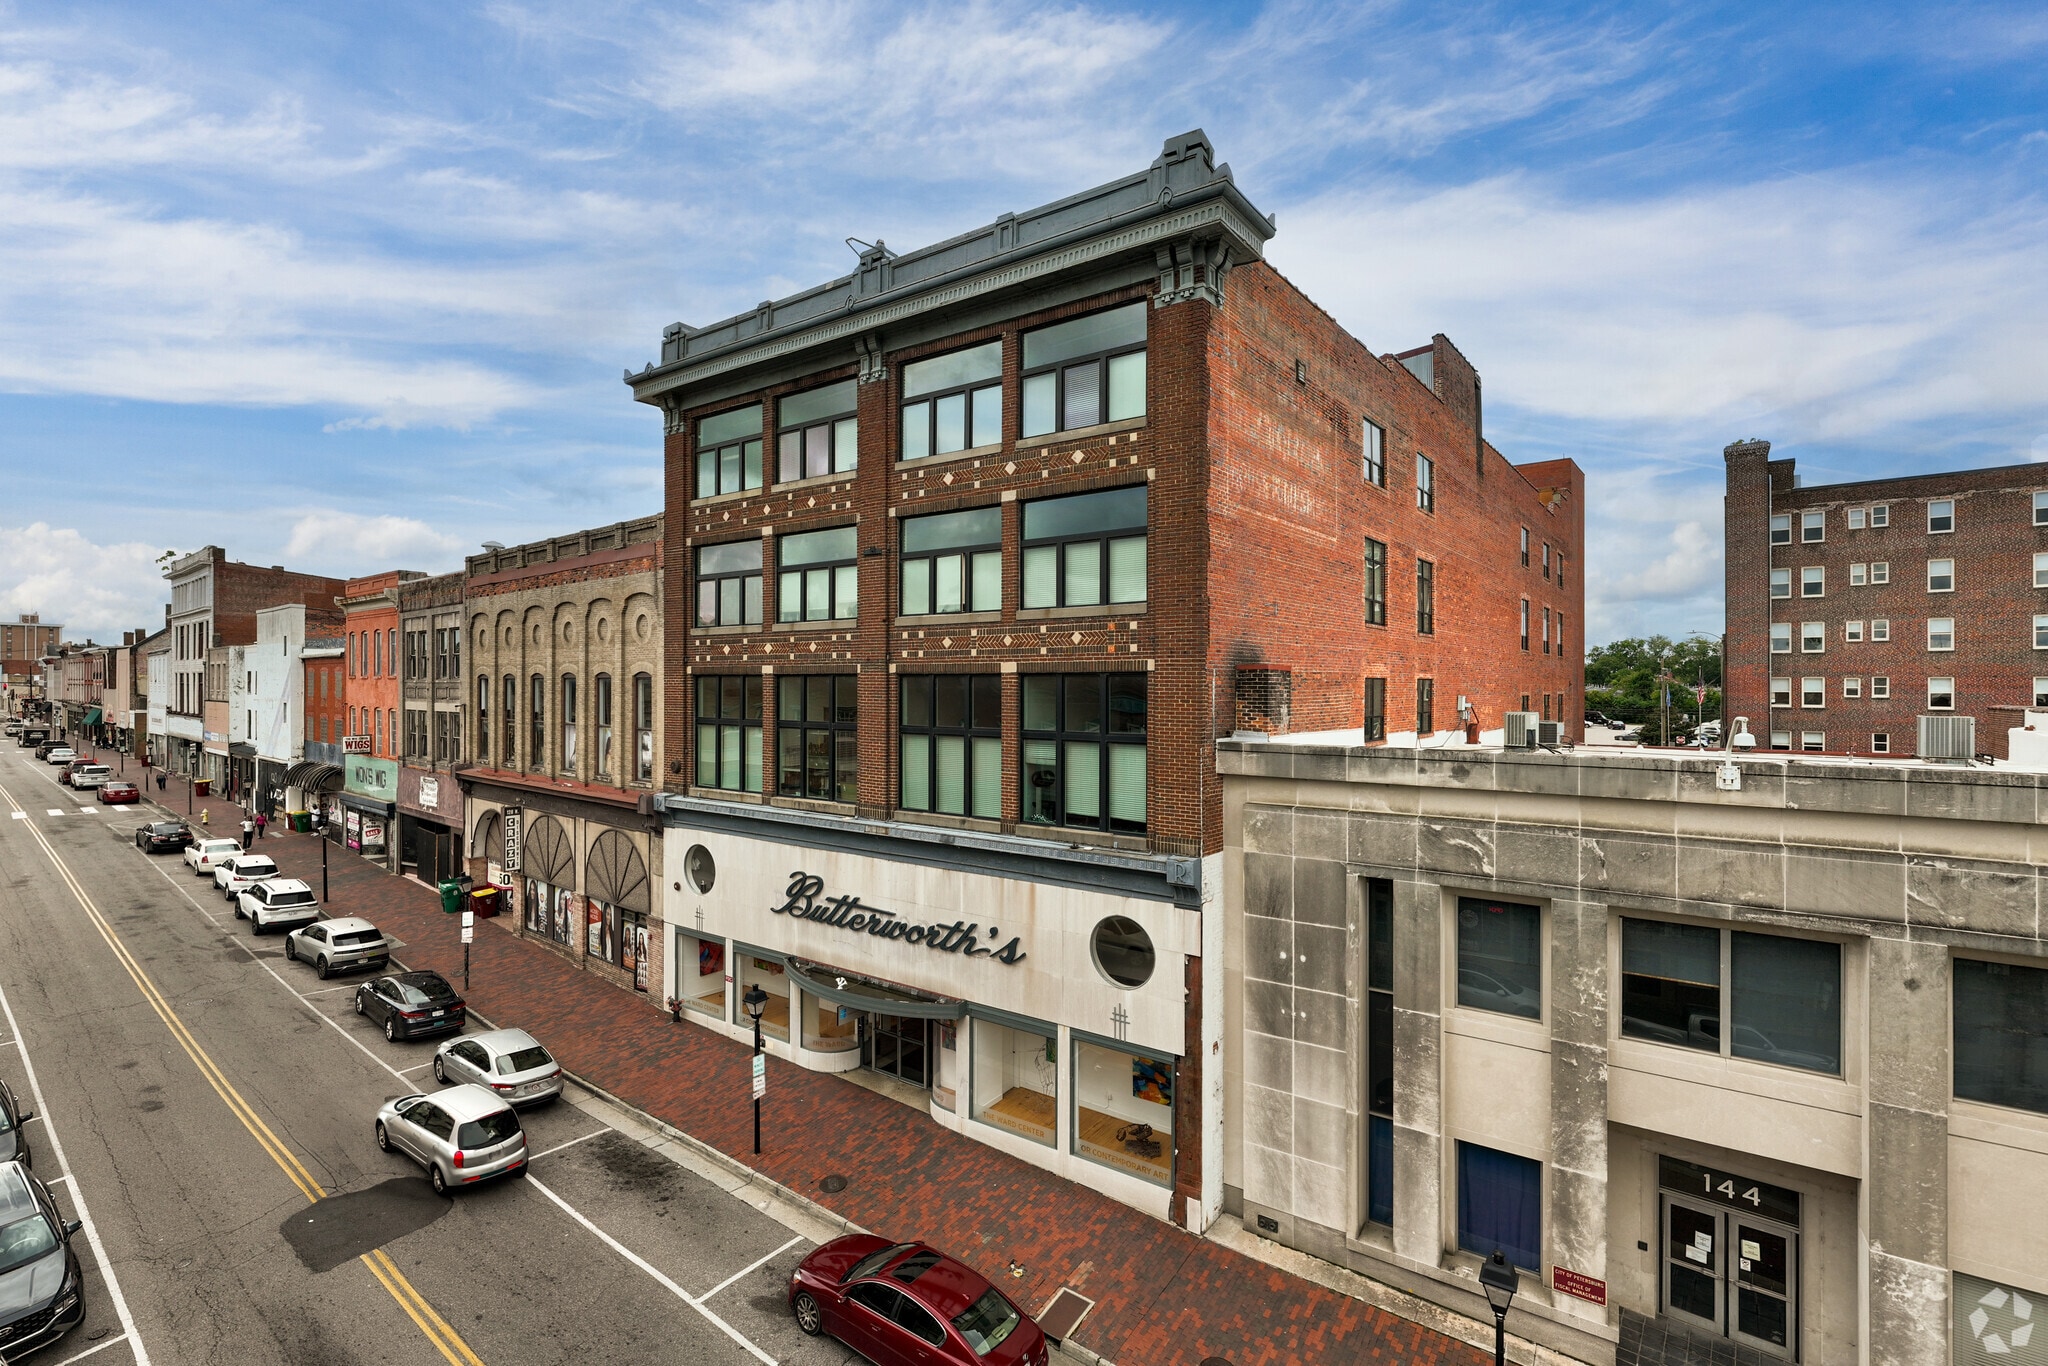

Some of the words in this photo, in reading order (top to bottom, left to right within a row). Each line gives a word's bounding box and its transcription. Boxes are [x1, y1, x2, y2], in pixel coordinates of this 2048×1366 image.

[345, 740, 370, 750] WIGS
[507, 818, 515, 868] CRAZY
[770, 871, 1027, 965] Butterworth's
[982, 1110, 995, 1121] THE
[996, 1115, 1017, 1129] WARD
[1018, 1122, 1045, 1138] CENTER
[1092, 1147, 1152, 1175] CONTEMPORARY
[1153, 1169, 1169, 1181] ART
[1703, 1173, 1761, 1207] 144
[1554, 1268, 1566, 1276] CITY
[1573, 1275, 1605, 1289] PETERSBURG
[1554, 1282, 1571, 1292] FISCAL
[1572, 1288, 1605, 1303] MANAGEMENT
[1567, 1281, 1584, 1290] OFFICE
